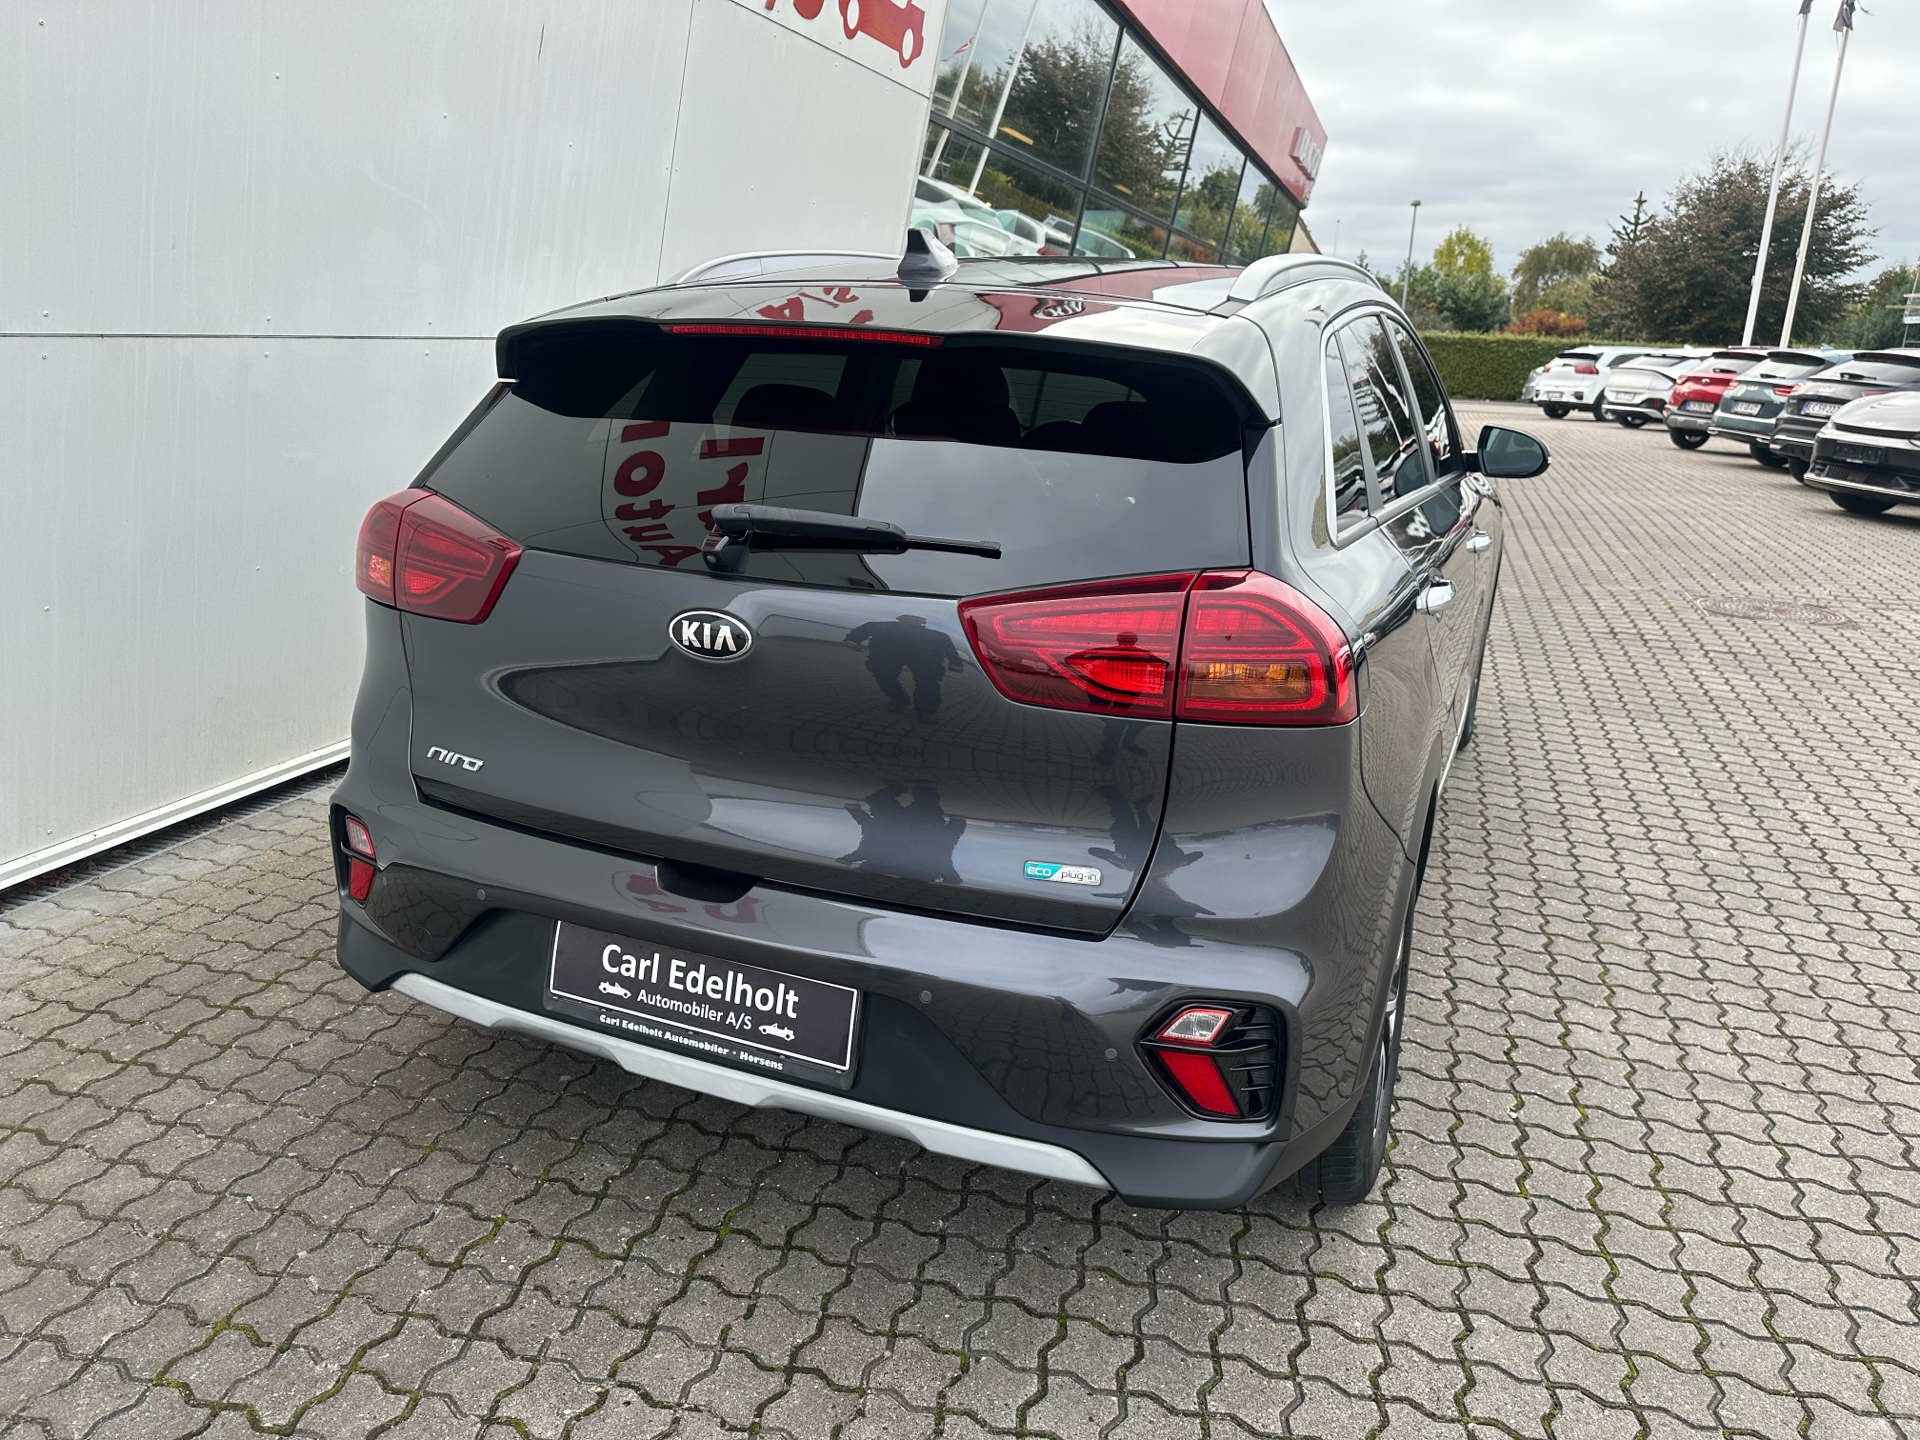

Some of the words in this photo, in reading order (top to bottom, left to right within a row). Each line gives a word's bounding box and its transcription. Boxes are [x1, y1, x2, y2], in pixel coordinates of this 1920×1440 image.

[681, 620, 737, 652] KIA
[1027, 866, 1052, 877] ECO
[1061, 870, 1097, 882] plug-in
[602, 944, 660, 984] Carl
[668, 959, 799, 1019] Edelholt
[636, 989, 724, 1023] Automobiler
[725, 1011, 752, 1030] A/S
[599, 1013, 620, 1027] Carl
[621, 1019, 663, 1038] Edelholt
[664, 1031, 730, 1056] Automobiler
[739, 1051, 784, 1071] Horsens
